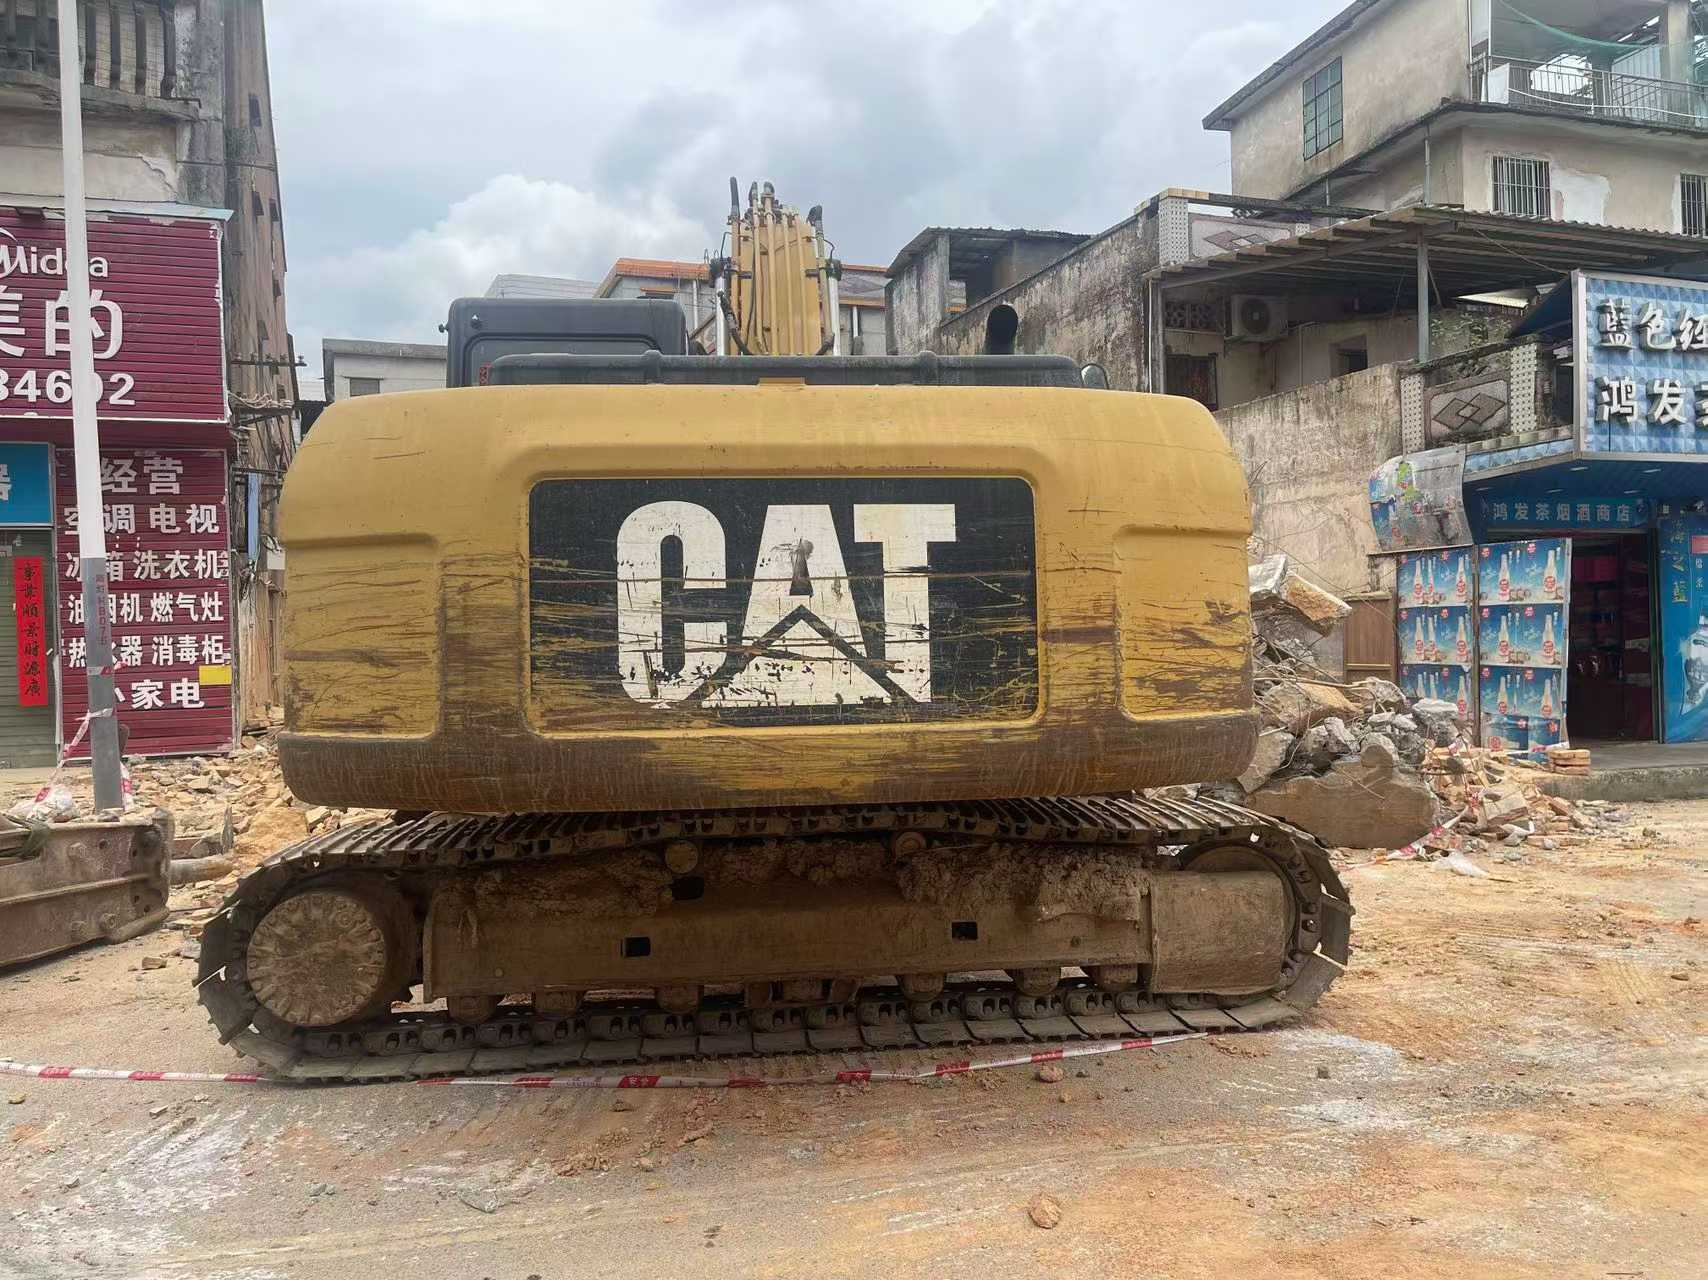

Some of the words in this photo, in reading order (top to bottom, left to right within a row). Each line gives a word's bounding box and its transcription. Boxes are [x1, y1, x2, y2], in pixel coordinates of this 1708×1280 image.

[0, 245, 108, 278] Mida
[1595, 375, 1708, 426] 鸿发
[101, 457, 183, 495] 经营
[150, 503, 219, 534] 电视
[133, 549, 222, 580] 洗衣机
[150, 591, 224, 622] 燃气灶
[617, 500, 956, 709] CAT
[69, 635, 143, 667] 热器
[151, 634, 224, 665] 消毒柜
